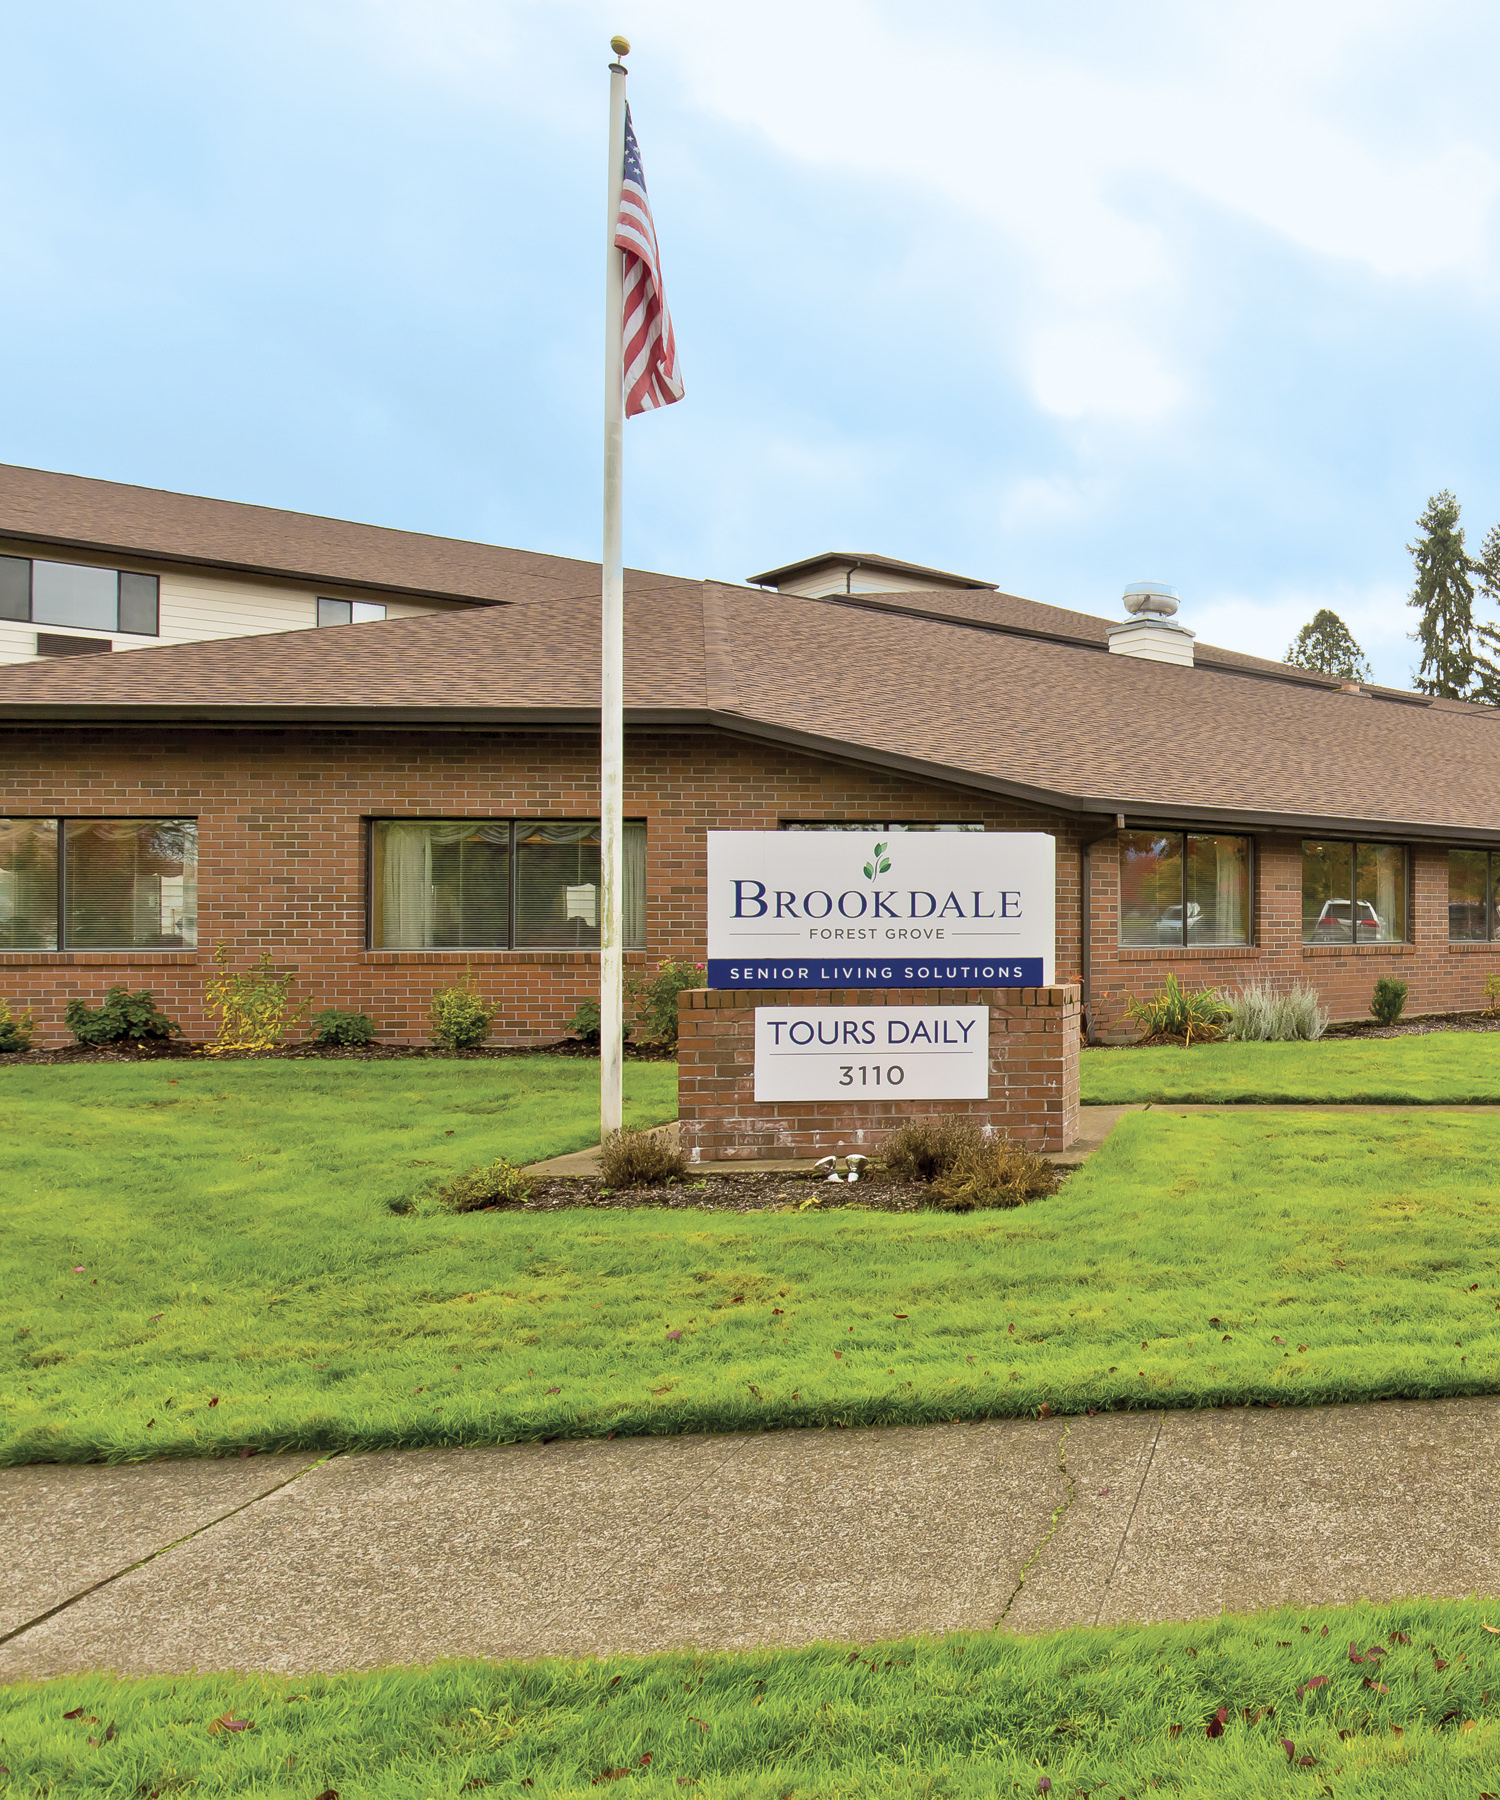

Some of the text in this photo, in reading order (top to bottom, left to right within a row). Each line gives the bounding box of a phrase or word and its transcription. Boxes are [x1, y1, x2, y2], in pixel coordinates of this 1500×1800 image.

[729, 879, 1023, 919] BROOKDALE
[809, 928, 945, 940] FOREST GROVE
[730, 966, 1023, 980] SENIOR LIVING SOLUTIONS
[766, 1019, 976, 1046] TOURS DAILY
[838, 1065, 905, 1087] 3110
